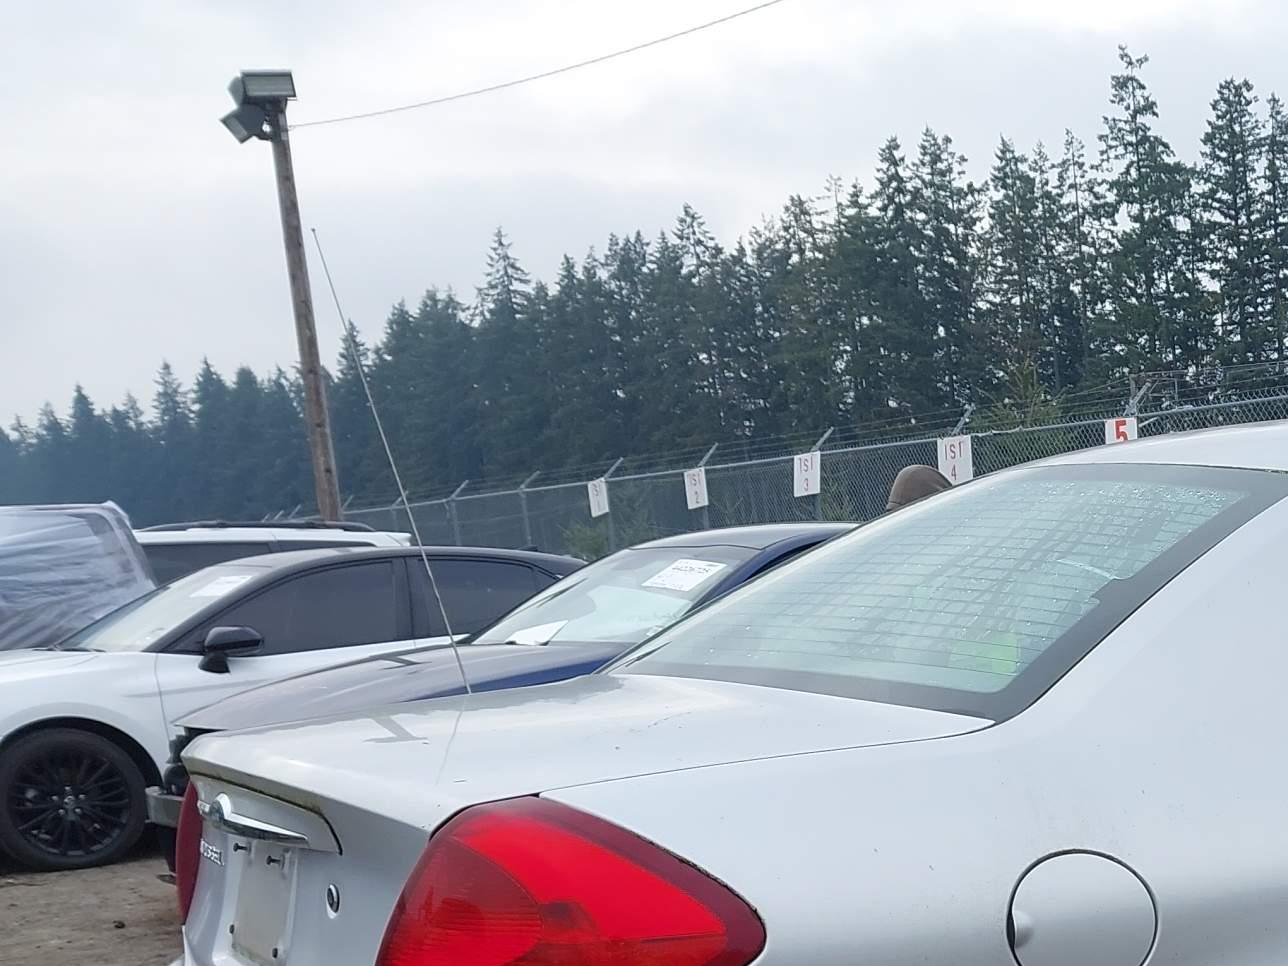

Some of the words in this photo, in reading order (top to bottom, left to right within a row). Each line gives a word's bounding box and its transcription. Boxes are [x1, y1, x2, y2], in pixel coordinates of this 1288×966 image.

[1114, 419, 1129, 442] 5
[951, 463, 957, 480] 4
[803, 478, 809, 492] 3
